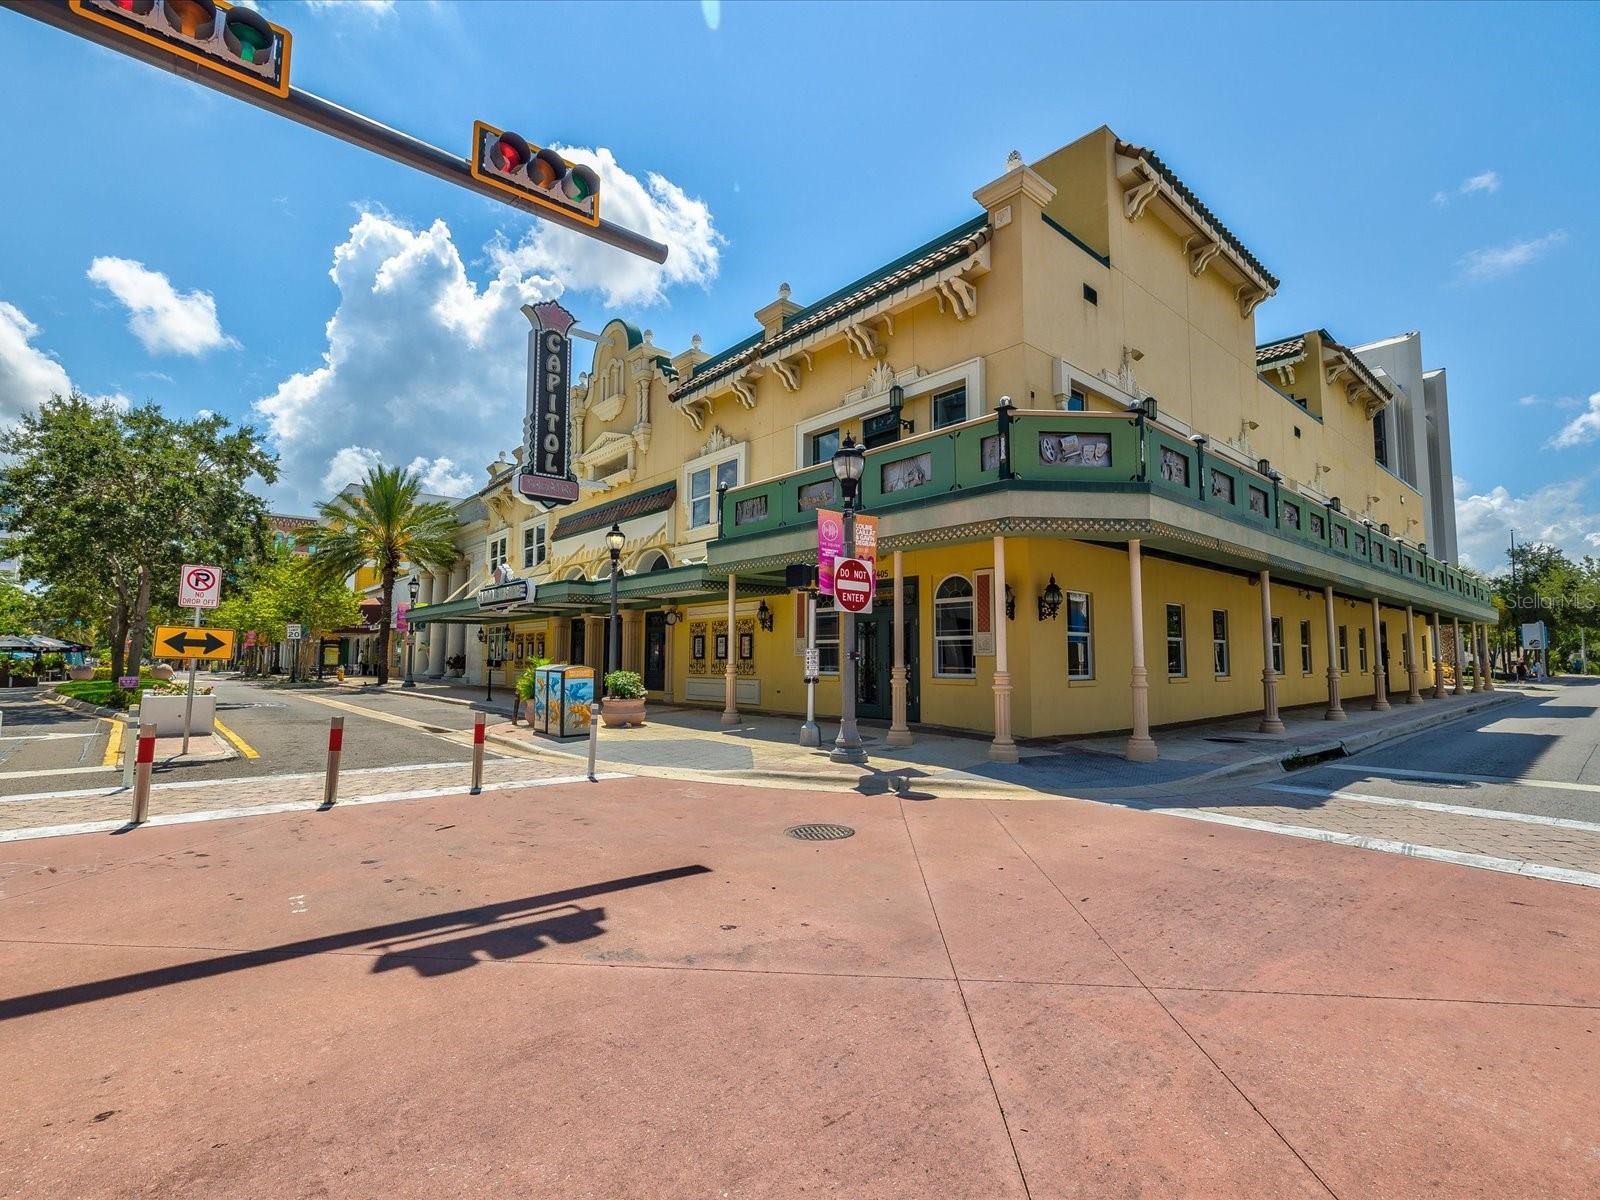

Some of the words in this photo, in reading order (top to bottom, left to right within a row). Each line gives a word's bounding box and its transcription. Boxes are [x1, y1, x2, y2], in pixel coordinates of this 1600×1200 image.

[543, 333, 561, 474] CAPITOL
[840, 568, 850, 578] DO
[853, 570, 867, 580] NOT
[842, 592, 865, 603] ENTER
